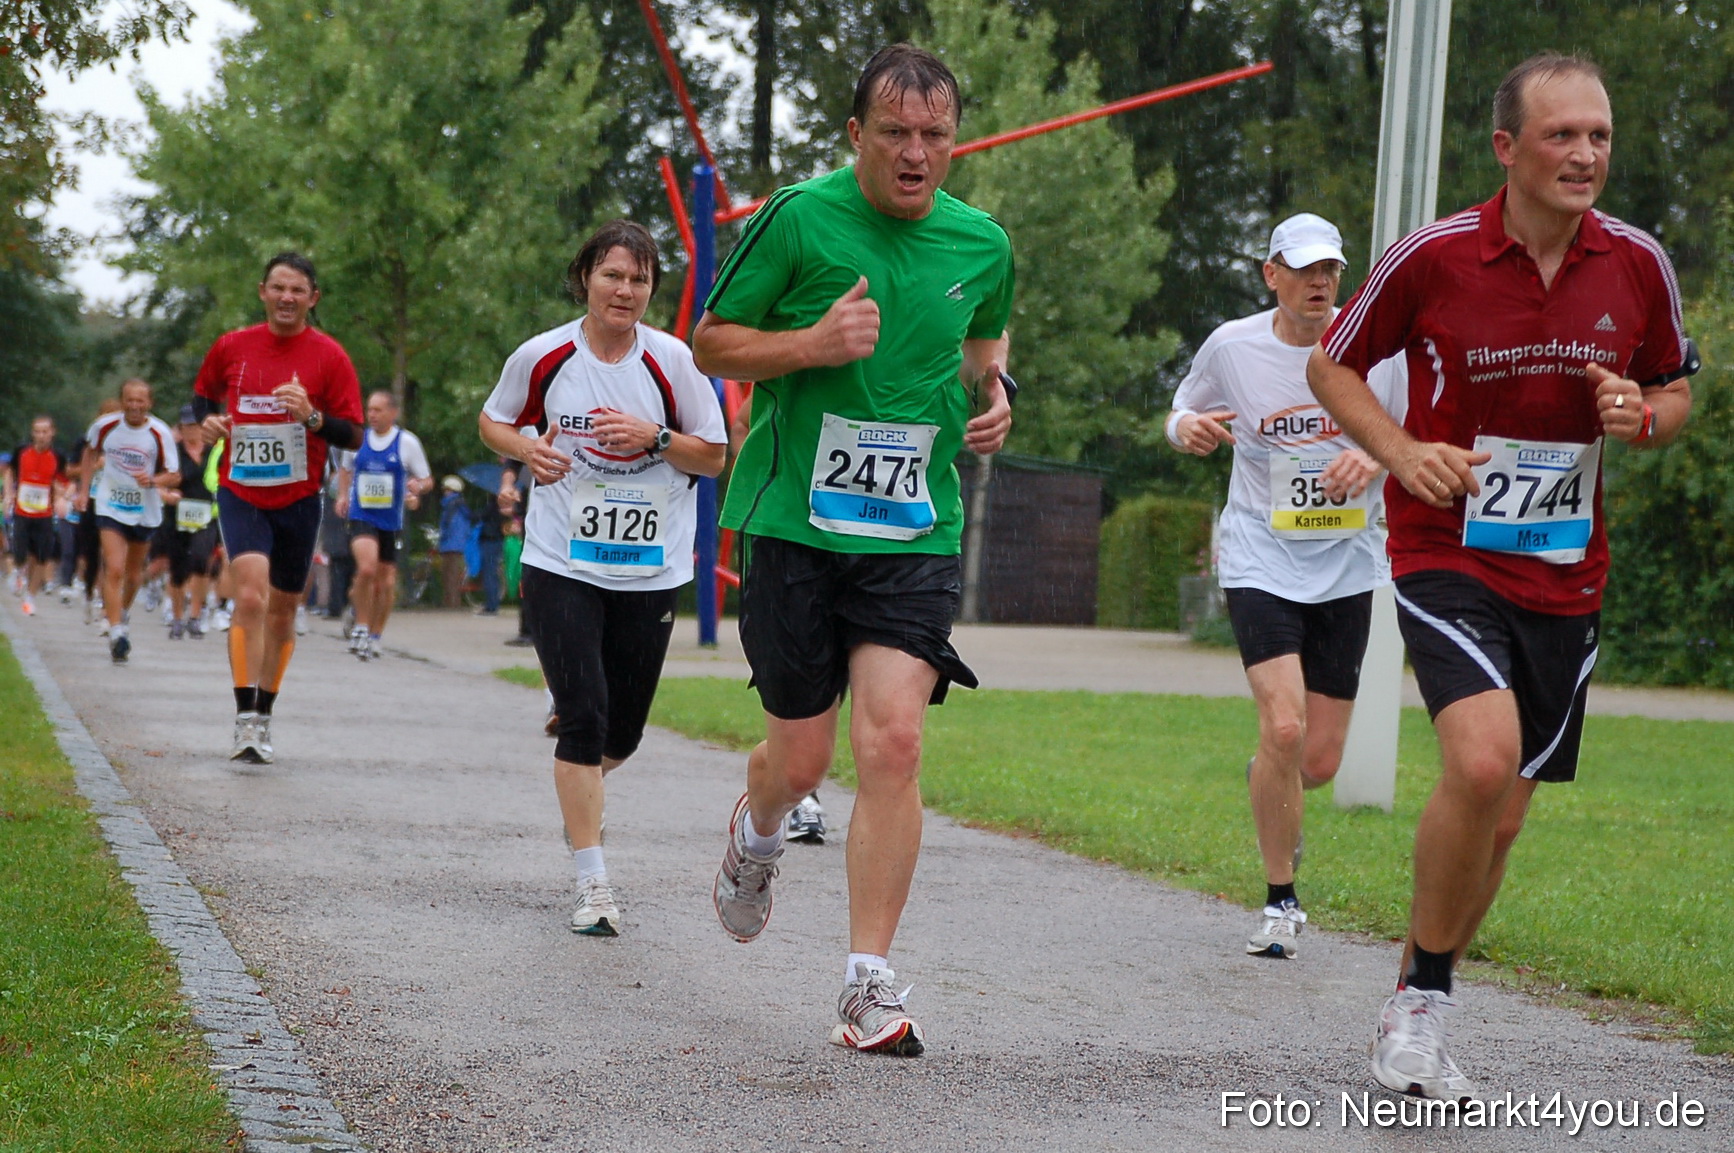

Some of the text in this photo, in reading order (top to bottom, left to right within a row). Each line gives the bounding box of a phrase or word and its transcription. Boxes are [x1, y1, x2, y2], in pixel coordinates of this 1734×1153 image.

[1466, 338, 1617, 367] Filmproduktion
[1470, 363, 1588, 382] www.1mann1wo
[859, 430, 907, 442] BOCK
[236, 441, 285, 464] 2136
[1518, 449, 1575, 463] BOCK
[573, 449, 664, 476] Das sportliche Autohaus
[824, 449, 922, 498] 2475
[110, 489, 142, 505] 3203
[604, 488, 644, 500] BOCK
[1481, 471, 1583, 518] 2744
[859, 502, 888, 520] Jan
[580, 506, 659, 542] 3126
[1295, 515, 1341, 527] Karsten
[1517, 530, 1550, 547] Max
[594, 547, 640, 562] Tamara
